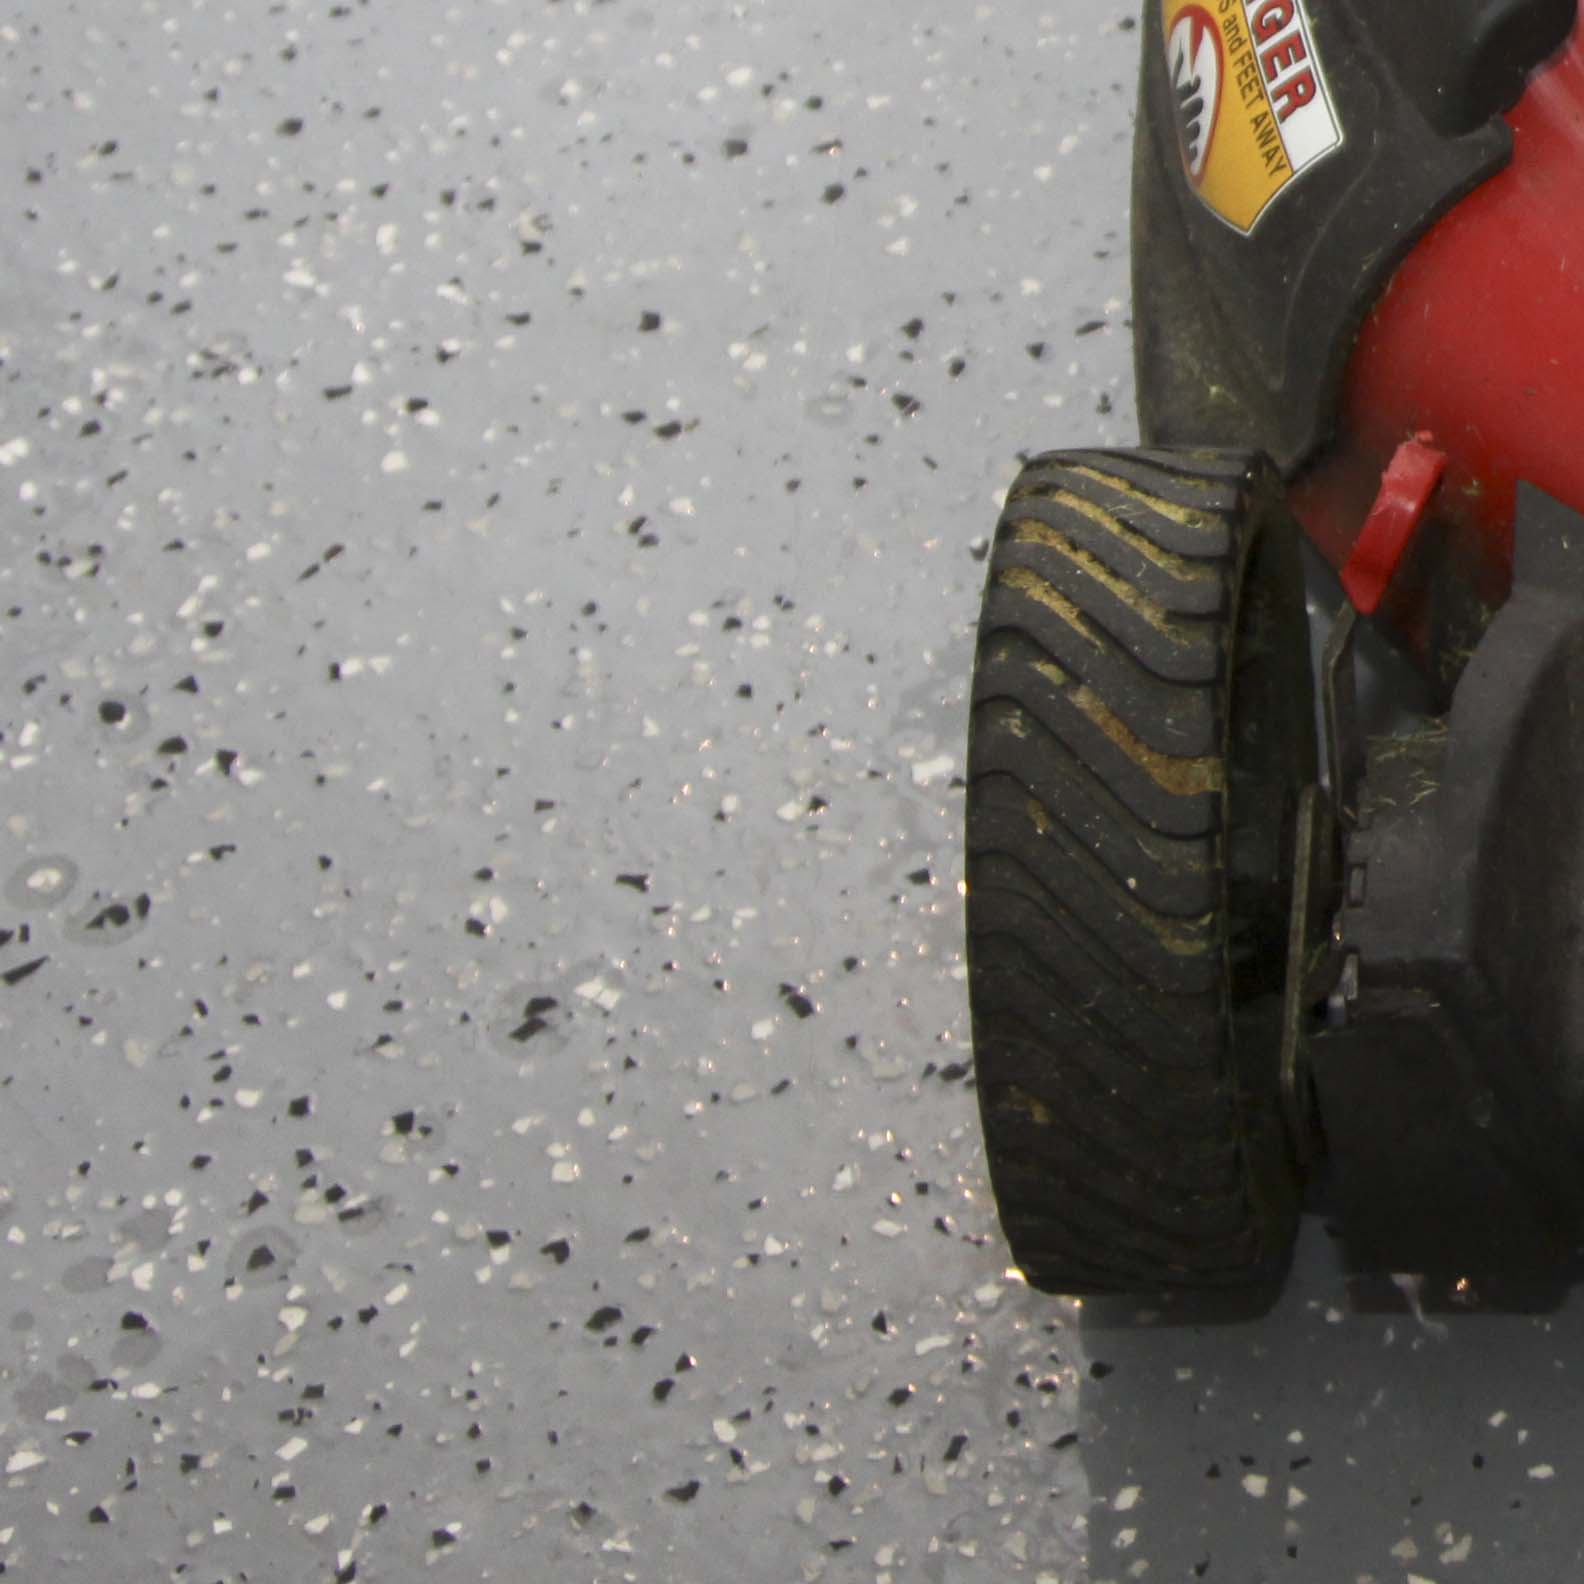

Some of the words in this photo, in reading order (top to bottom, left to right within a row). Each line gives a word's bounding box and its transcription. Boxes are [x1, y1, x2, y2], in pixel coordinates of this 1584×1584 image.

[1222, 15, 1248, 56] and
[1233, 50, 1264, 109] FEET
[1250, 111, 1287, 177] AWAY
